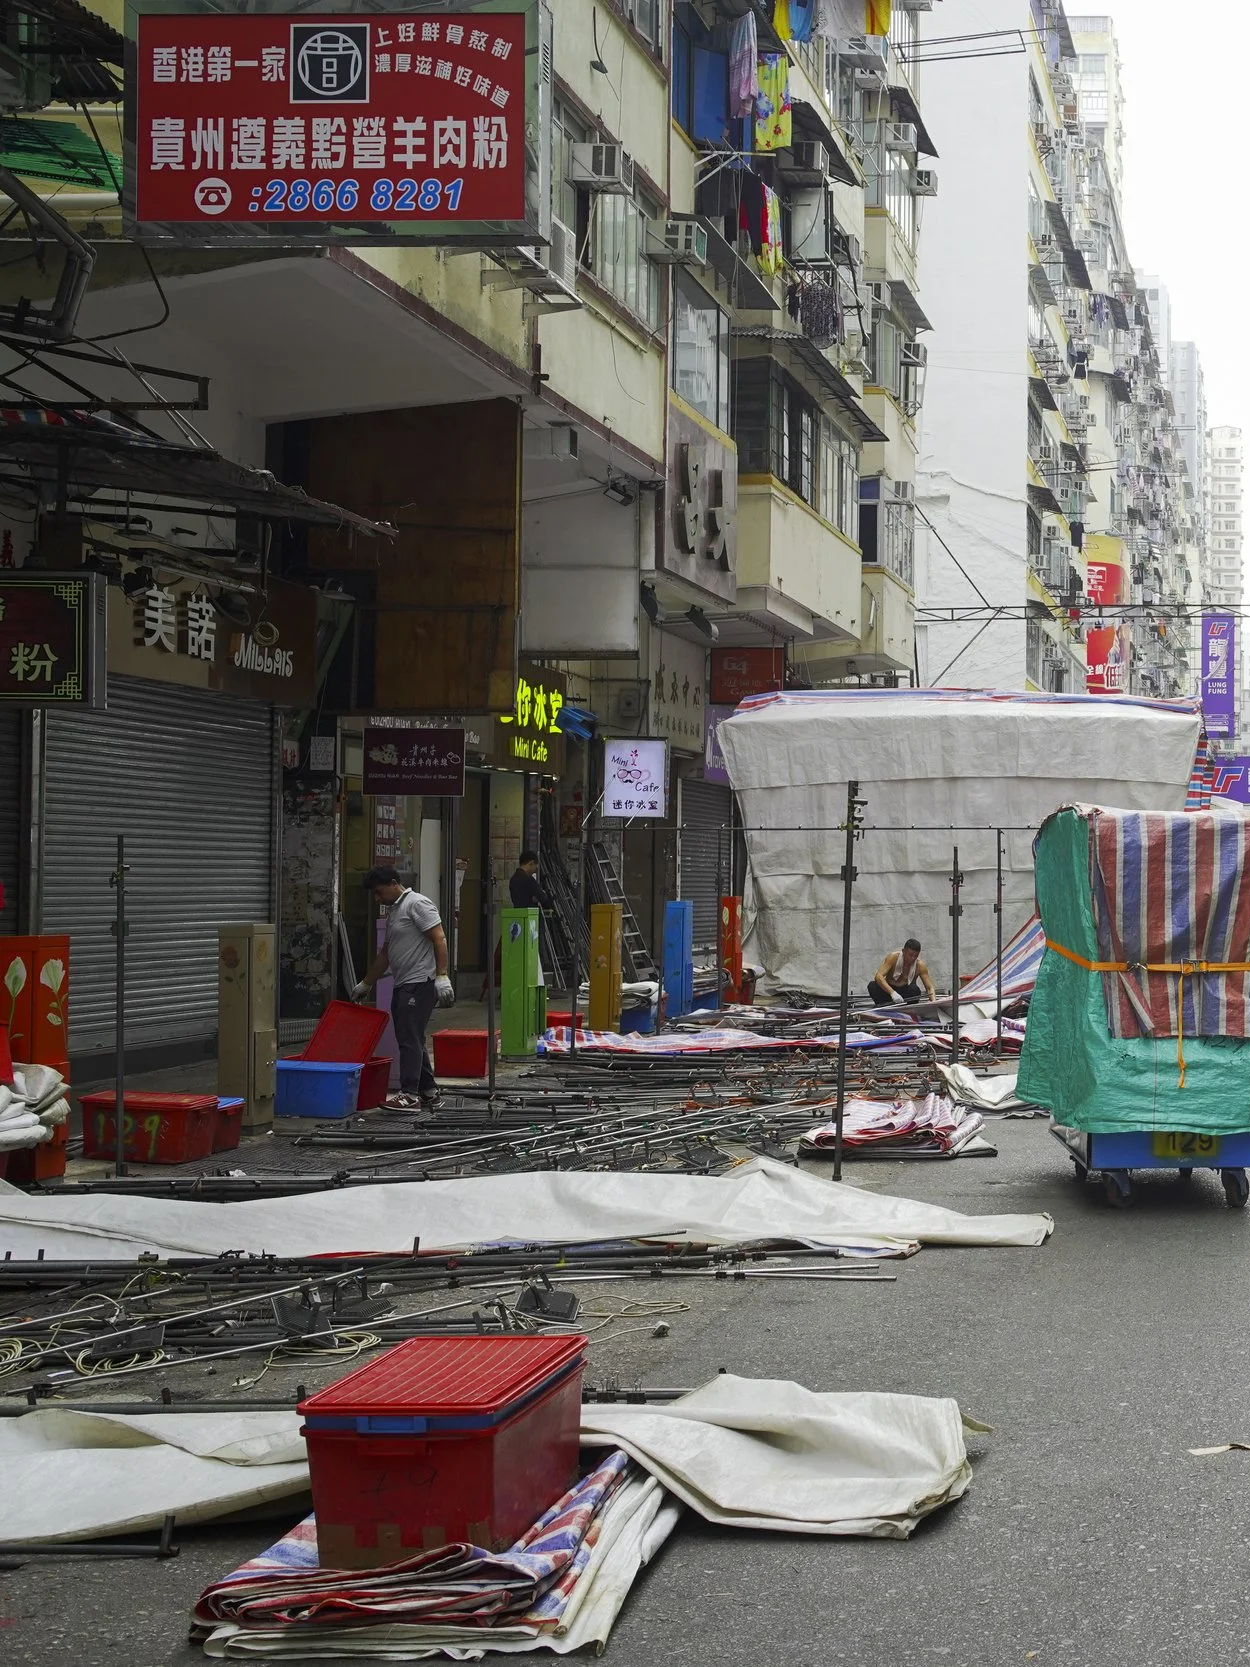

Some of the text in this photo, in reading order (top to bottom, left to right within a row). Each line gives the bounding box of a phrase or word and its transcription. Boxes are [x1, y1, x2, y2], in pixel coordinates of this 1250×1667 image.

[374, 22, 513, 60] 上好鮮骨熬制
[152, 46, 286, 83] 香港第一家
[374, 53, 510, 109] 濃厚滋補好味道
[150, 116, 509, 170] 貴州遵義黔營羊肉粉
[370, 177, 464, 212] 8281
[143, 582, 217, 662] 美諾
[9, 642, 59, 682] 粉
[514, 736, 547, 762] Mini Cafe
[612, 755, 628, 767] Mini
[635, 782, 660, 792] Cafe
[97, 1113, 161, 1158] 129
[1167, 1131, 1214, 1152] 129
